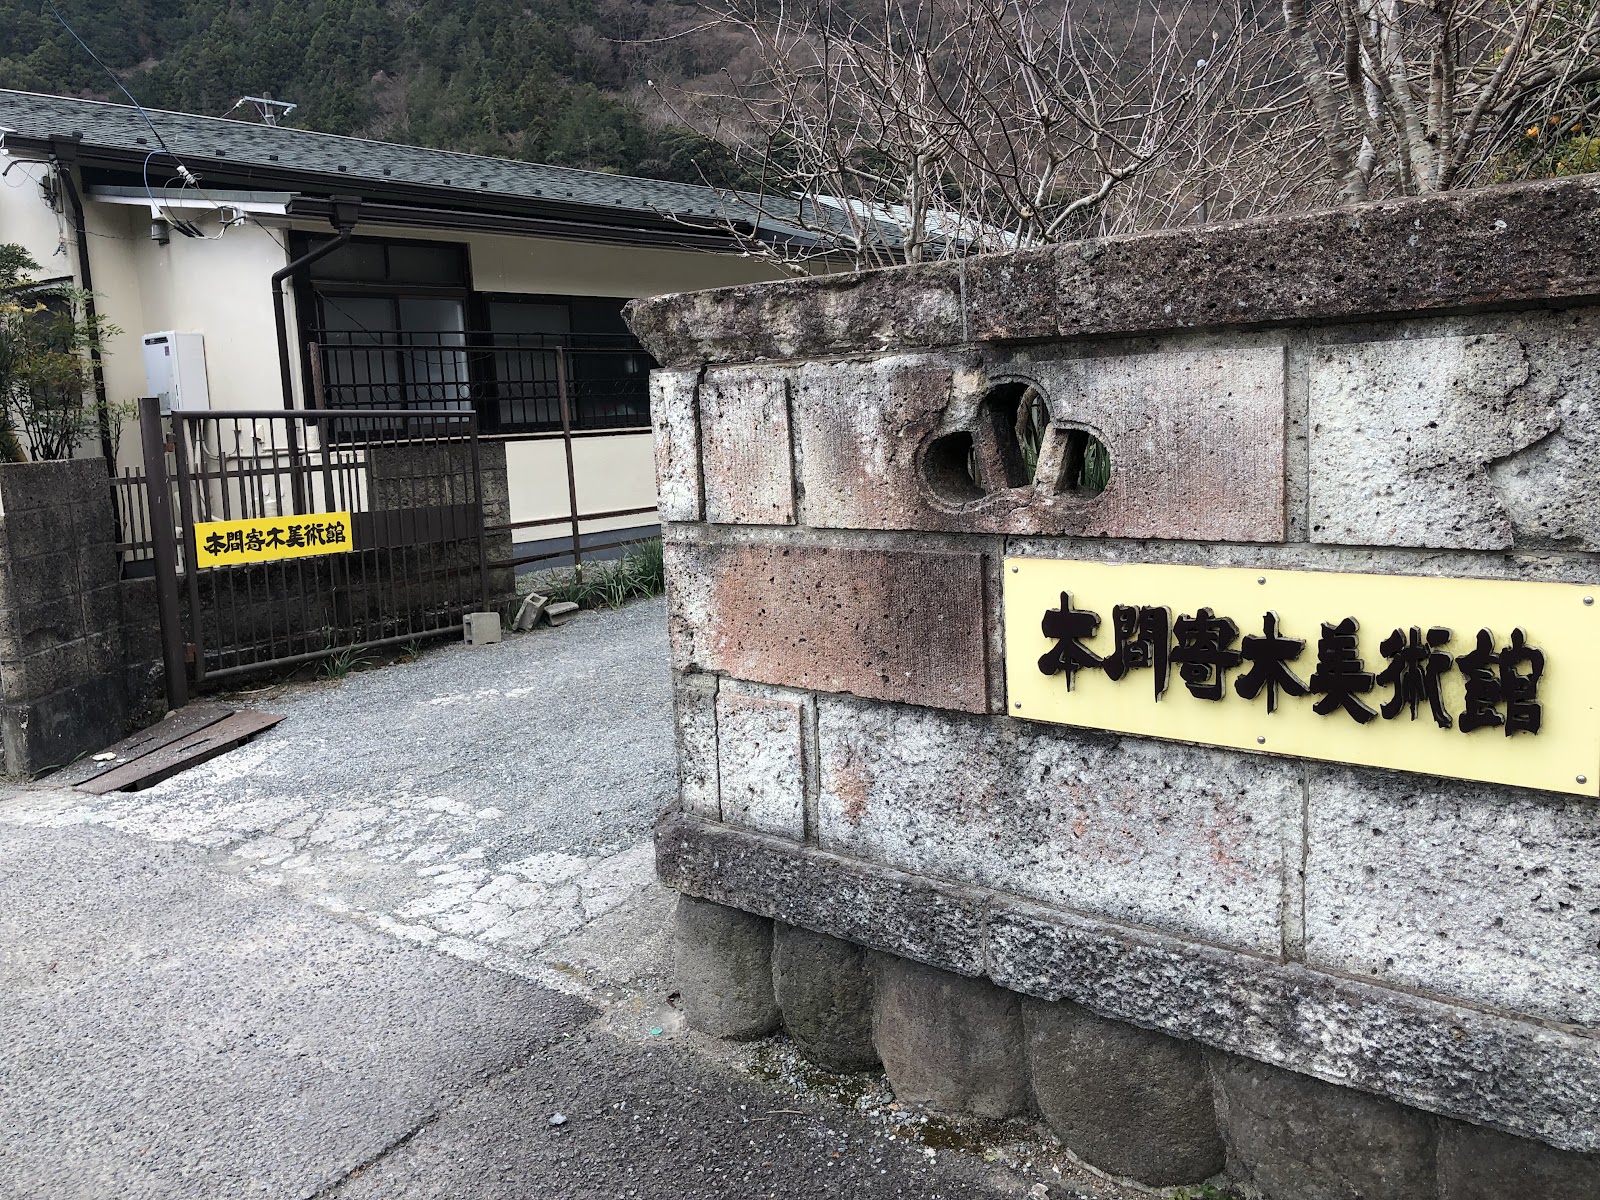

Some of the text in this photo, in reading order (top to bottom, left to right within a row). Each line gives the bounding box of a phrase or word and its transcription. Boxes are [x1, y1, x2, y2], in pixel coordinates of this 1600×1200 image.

[203, 520, 346, 556] 本間寄木美術館
[1038, 590, 1546, 738] 本間寄木美術館
